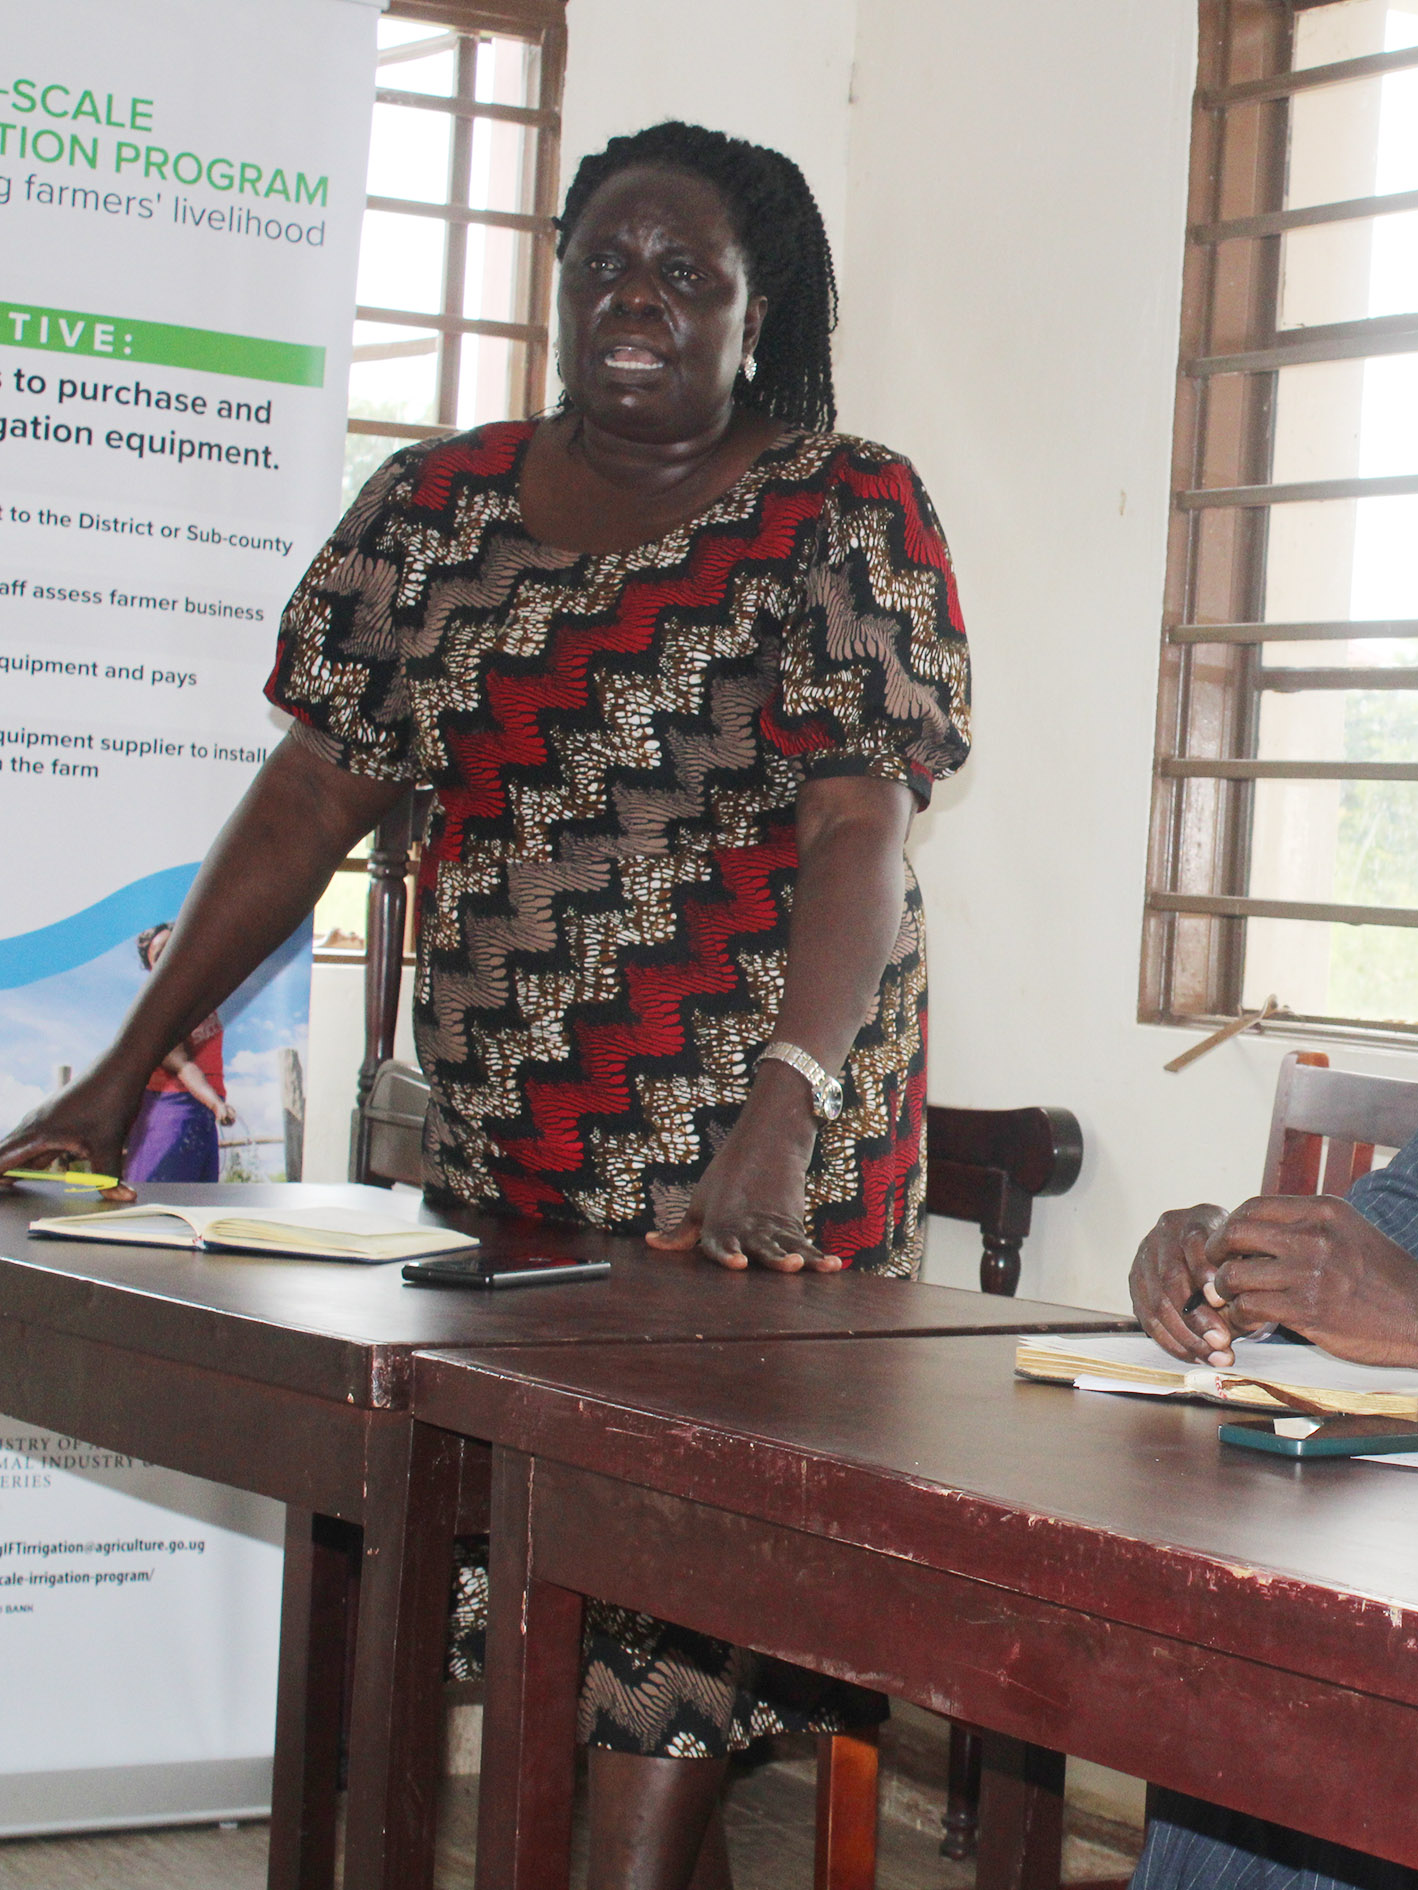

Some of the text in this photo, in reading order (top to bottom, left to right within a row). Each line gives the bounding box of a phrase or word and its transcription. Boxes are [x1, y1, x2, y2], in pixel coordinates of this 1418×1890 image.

[0, 122, 329, 208] TION PROGRAM
[25, 174, 162, 219] farmers'
[173, 197, 326, 247] livelihood
[9, 311, 133, 356] TIVE:
[14, 369, 46, 395] to
[58, 378, 207, 416] purchase
[216, 399, 272, 425] and
[105, 430, 280, 471] equipment.
[10, 506, 31, 523] to
[38, 509, 71, 528] the
[79, 512, 154, 536] District
[160, 525, 181, 539] or
[187, 525, 293, 556] Sub-county
[0, 580, 265, 621] aff assess farmer business
[105, 665, 144, 681] and
[151, 670, 197, 688] pays
[11, 756, 44, 775] the
[51, 759, 99, 778] farm
[100, 737, 184, 758] supplier
[191, 745, 208, 759] to
[213, 744, 266, 763] install
[42, 1455, 133, 1469] INDUSTRY
